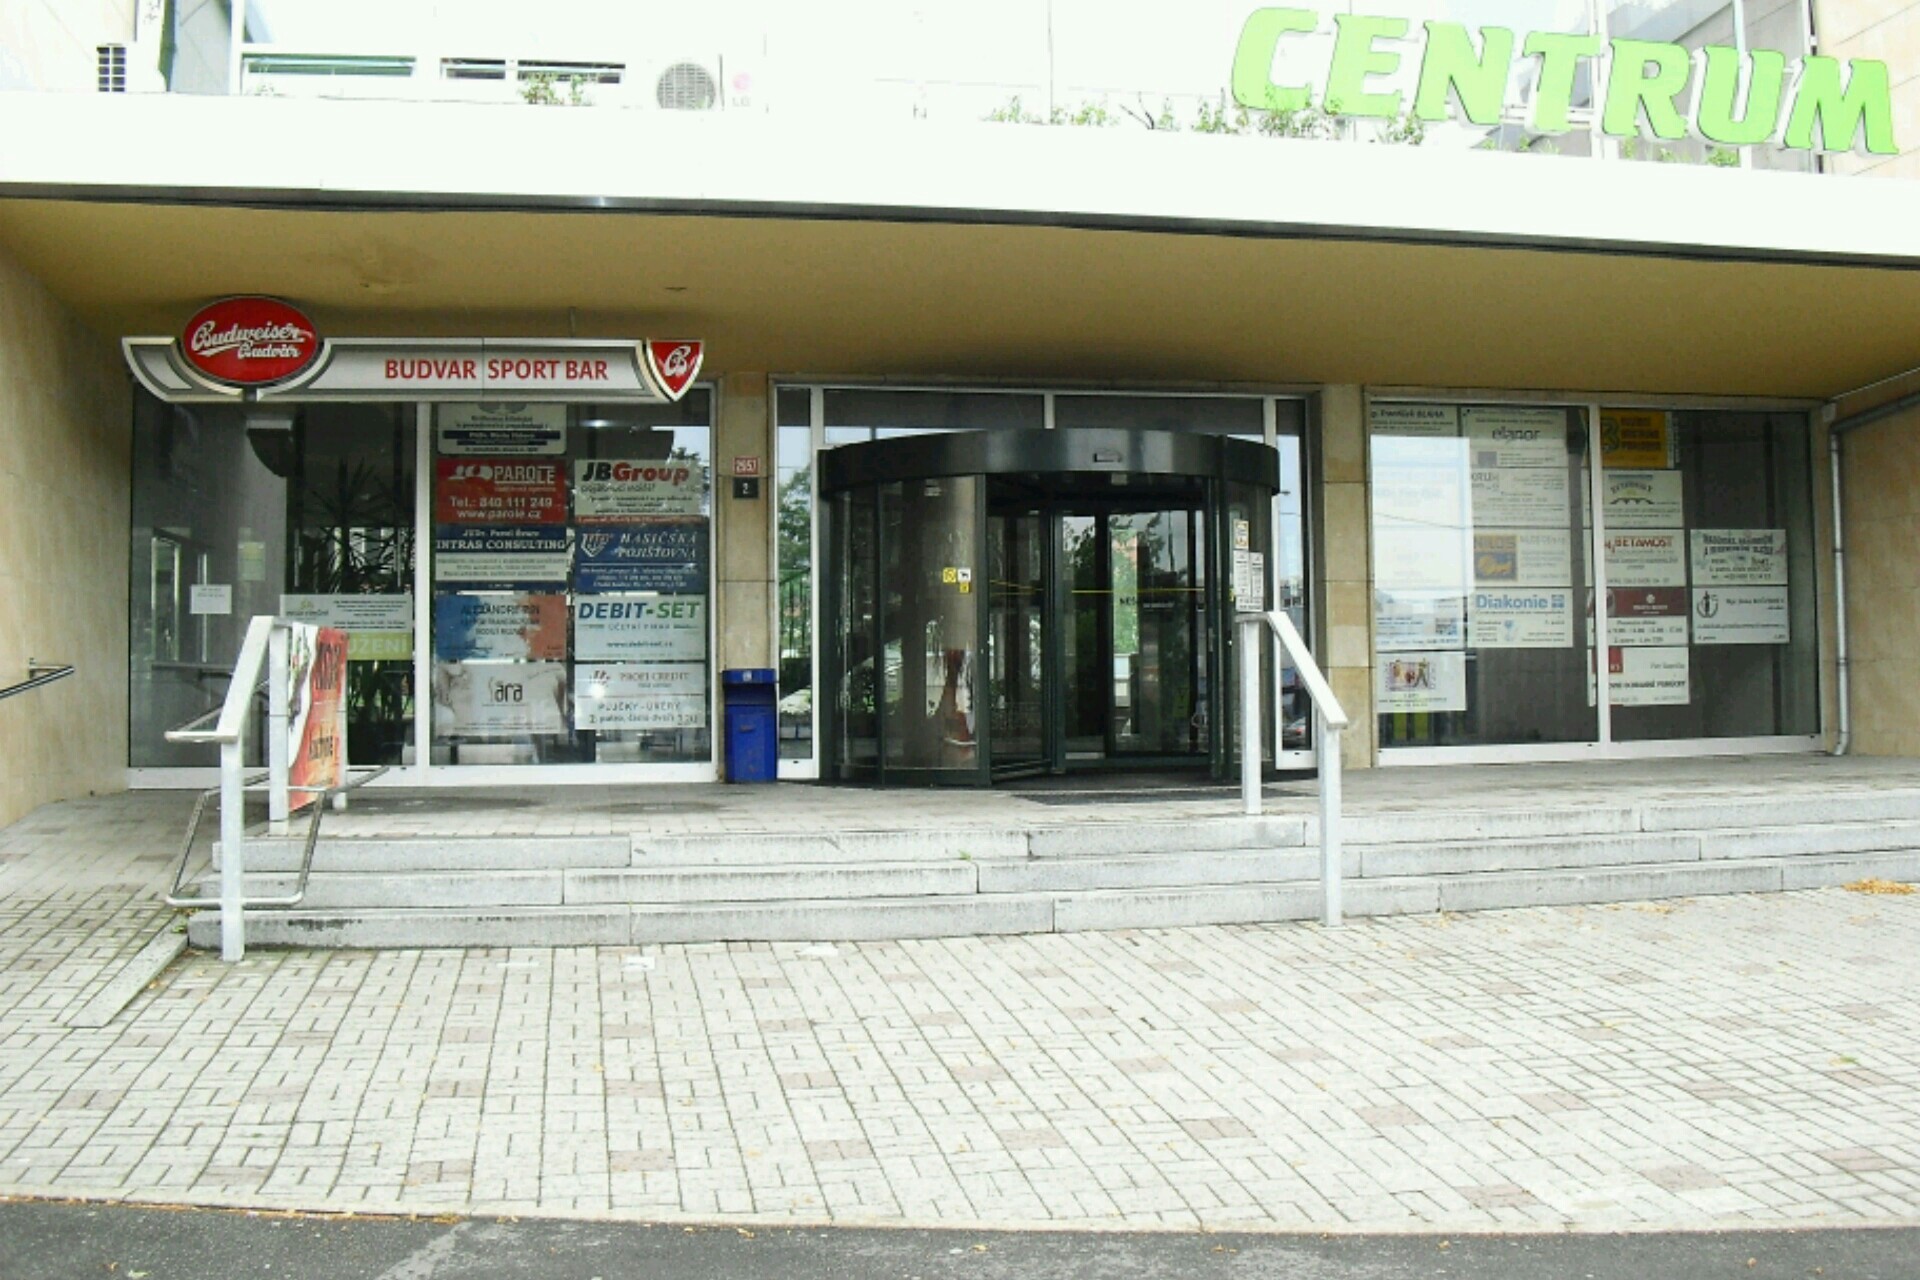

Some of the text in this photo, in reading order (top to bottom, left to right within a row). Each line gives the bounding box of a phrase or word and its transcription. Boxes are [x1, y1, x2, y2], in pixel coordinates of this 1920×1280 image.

[1231, 8, 1899, 155] CENTRUM
[191, 320, 314, 351] Budweiser
[384, 359, 609, 380] BUDVAR SPORT BAR
[494, 465, 556, 485] PAROLE
[582, 462, 690, 486] JBGroup
[742, 482, 750, 495] 2
[437, 540, 565, 549] INTRAS CONSULTING
[579, 602, 701, 619] DEBIT-SET
[1476, 594, 1549, 609] Diakonie
